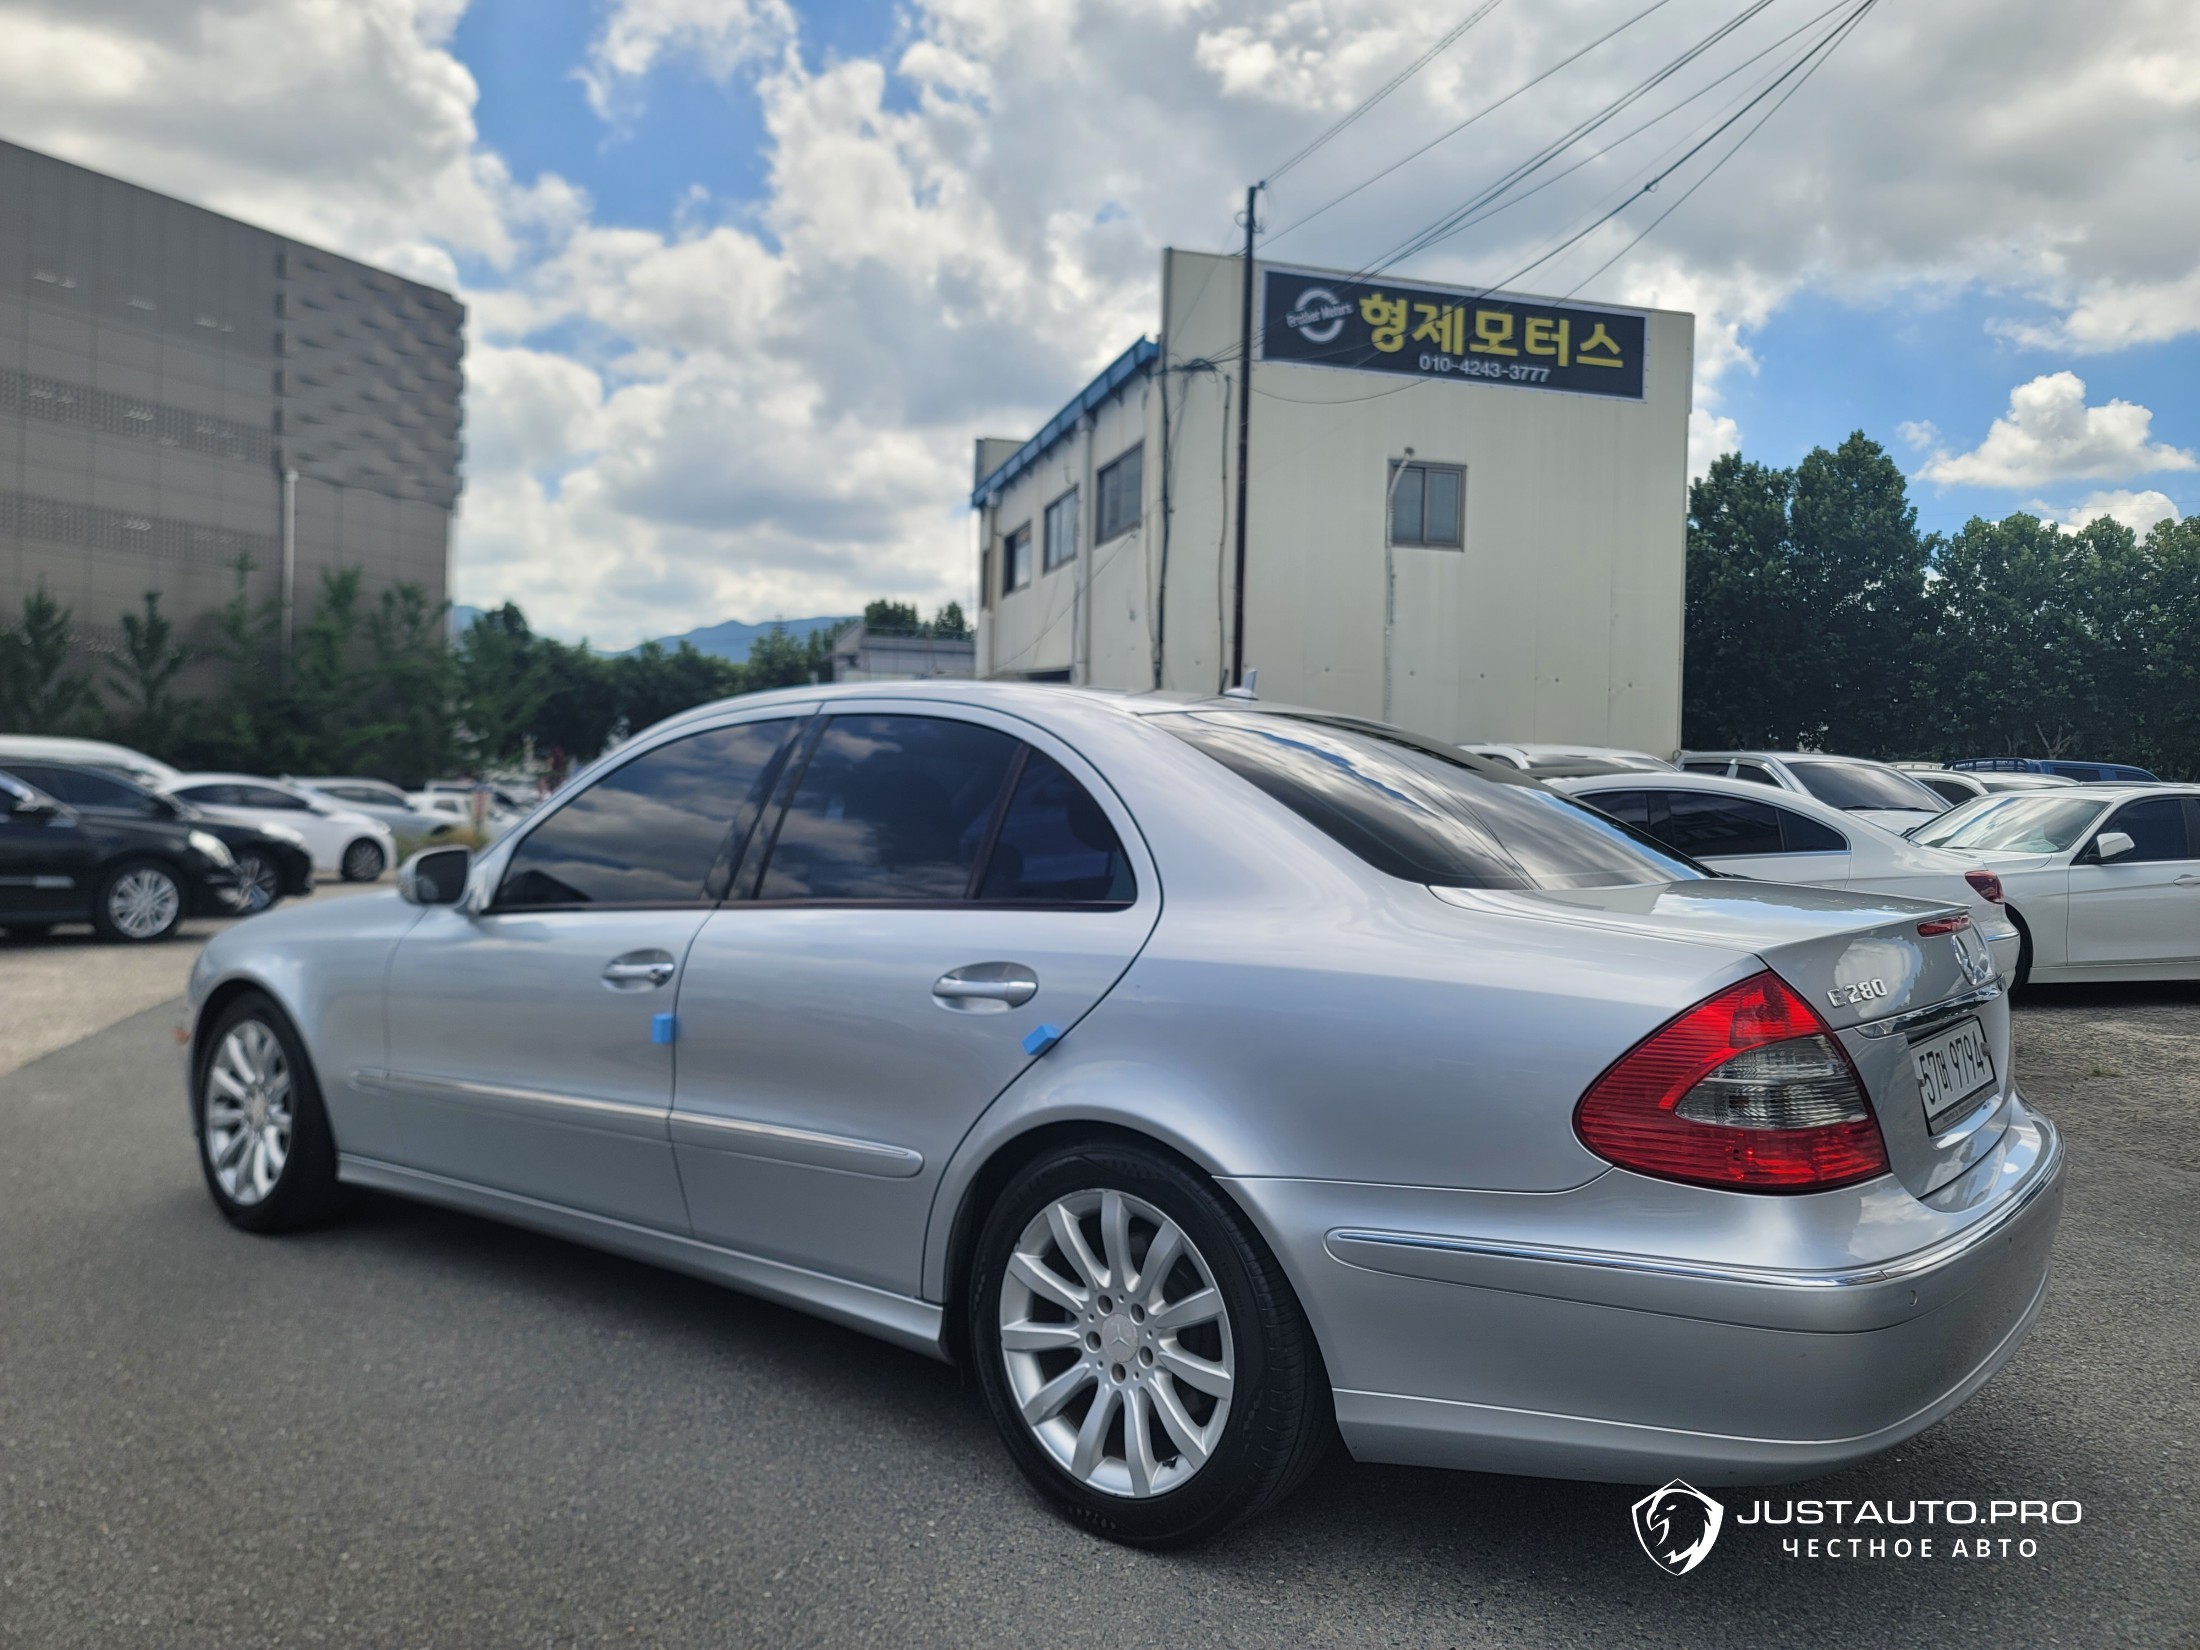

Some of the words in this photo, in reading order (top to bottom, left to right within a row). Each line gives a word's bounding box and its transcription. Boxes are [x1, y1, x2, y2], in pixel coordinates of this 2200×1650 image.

[1358, 292, 1624, 369] 형제모터스
[1419, 353, 1551, 383] 010-4243-3777
[1826, 988, 1846, 1009] E
[1844, 978, 1888, 1004] 280
[1948, 1030, 1986, 1089] 9794
